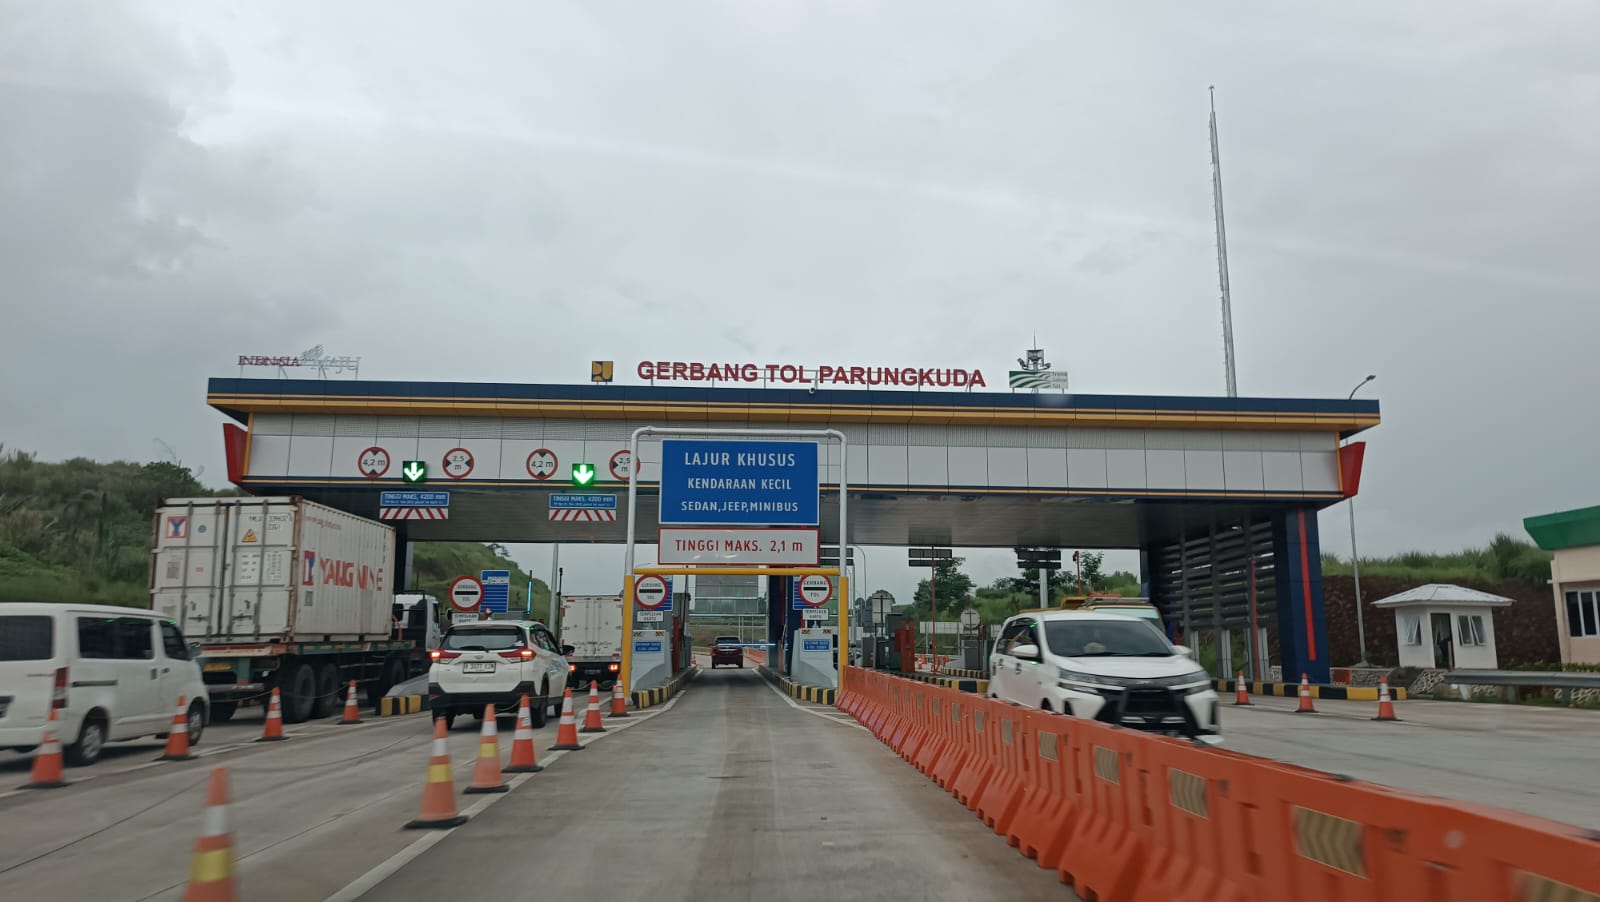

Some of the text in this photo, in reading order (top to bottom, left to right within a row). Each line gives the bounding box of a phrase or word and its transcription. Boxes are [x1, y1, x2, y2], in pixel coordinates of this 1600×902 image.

[637, 361, 986, 387] GERBANG TOL PARUNGKUDA
[362, 457, 376, 468] 4,2
[531, 459, 545, 470] 4,2
[684, 452, 796, 467] LAJUR KHUSUS
[687, 478, 792, 490] KENDARAAN KECIL
[675, 540, 803, 553] TINGGI MAKS. 2,1 m
